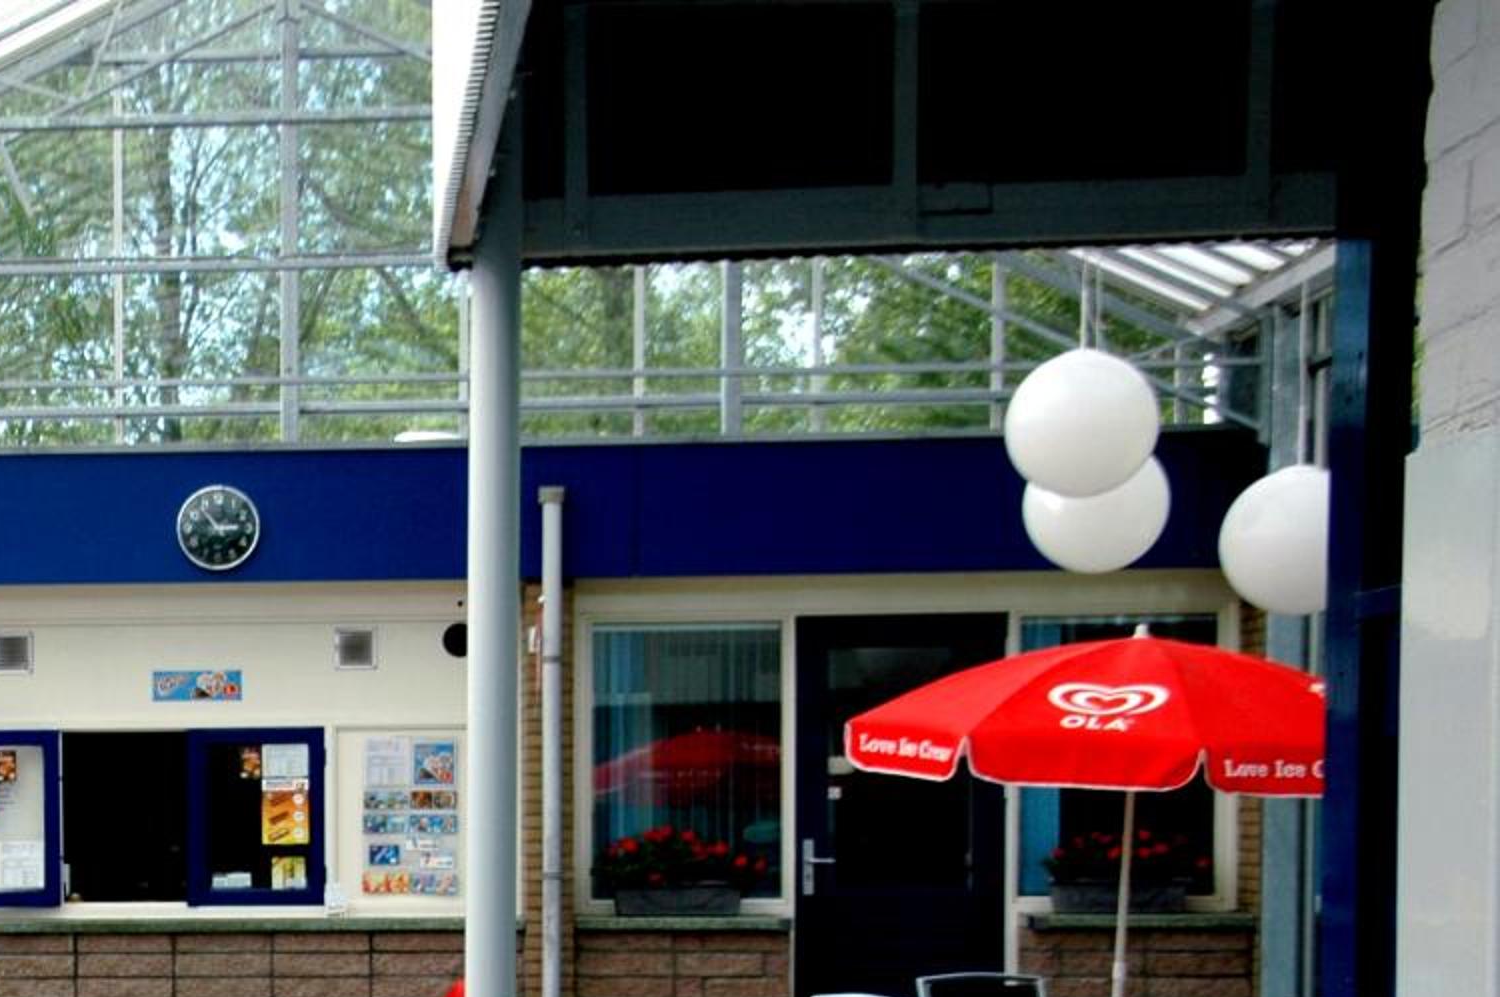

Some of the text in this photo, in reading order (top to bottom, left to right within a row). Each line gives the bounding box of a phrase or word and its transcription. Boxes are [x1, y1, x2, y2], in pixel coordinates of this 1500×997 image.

[1060, 714, 1128, 732] OLA
[859, 733, 897, 756] Love
[1224, 759, 1269, 778] Love
[1274, 759, 1306, 778] Ice
